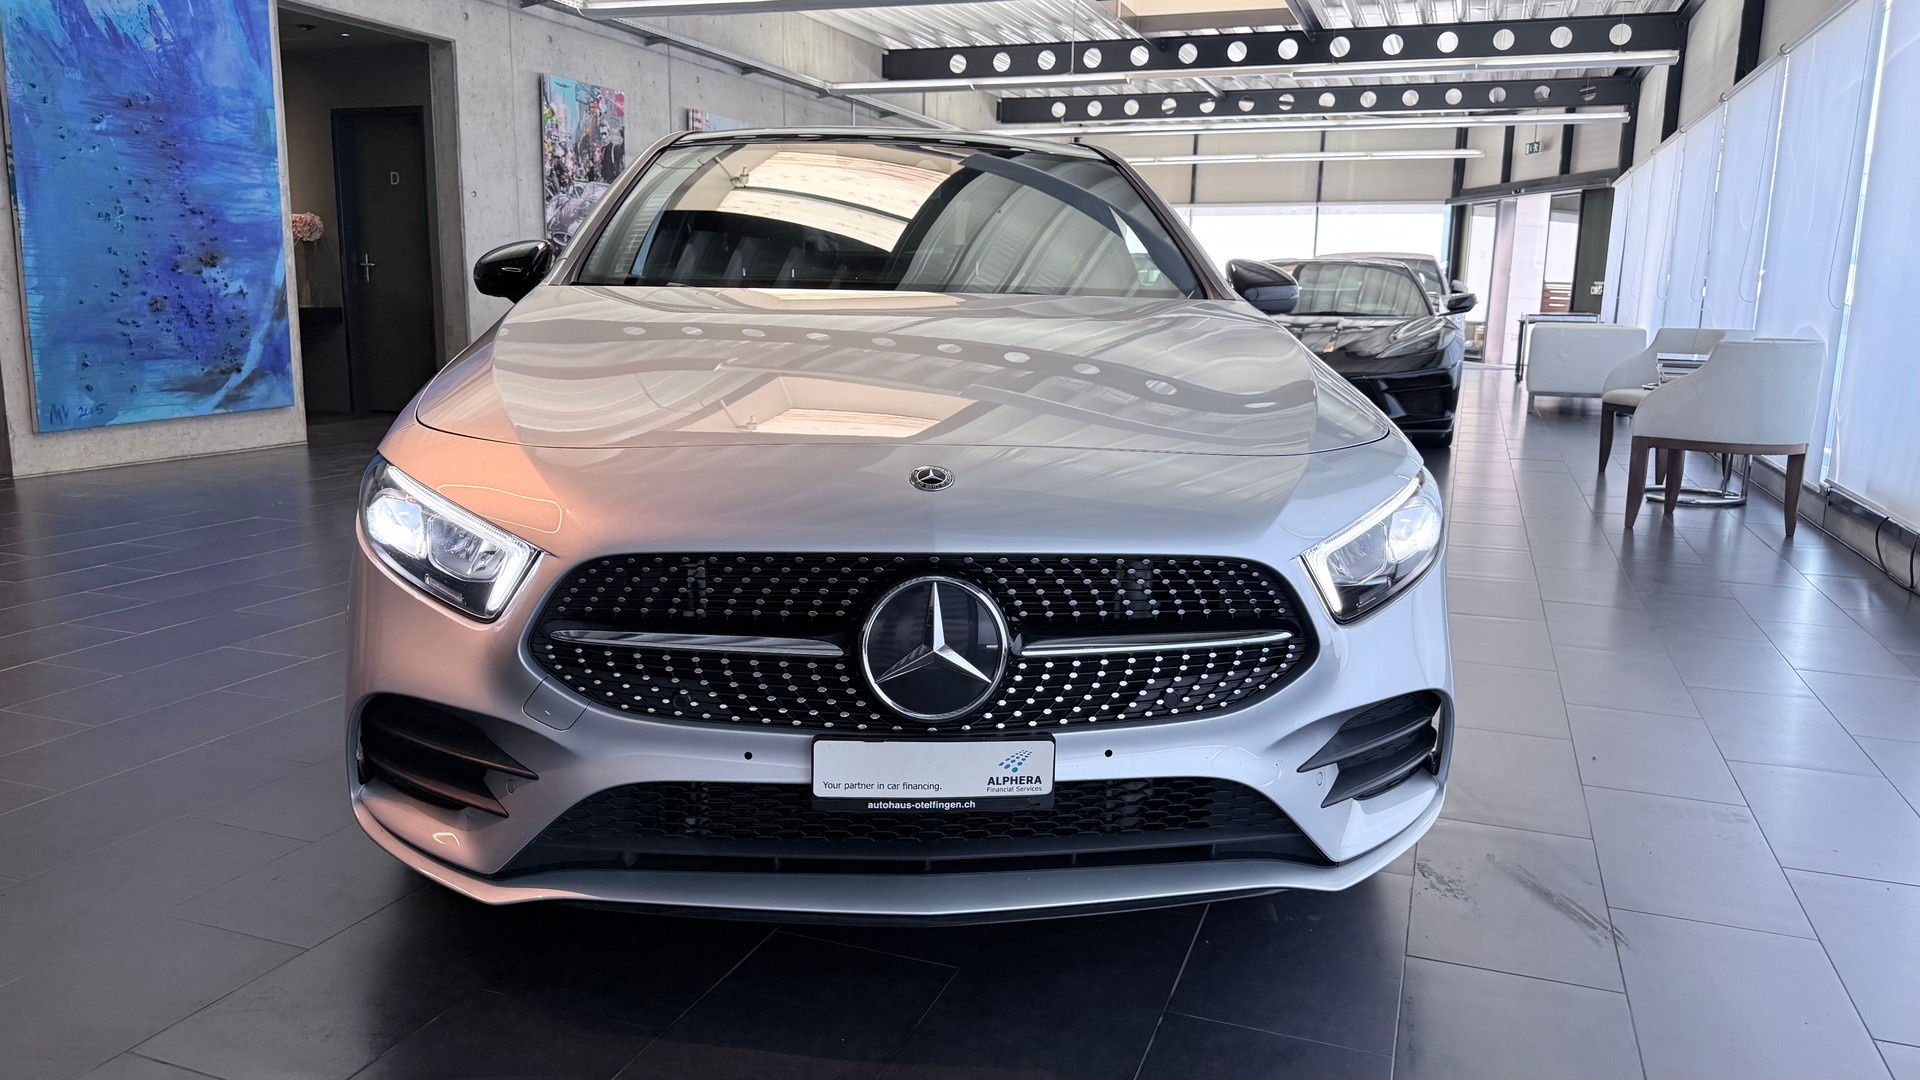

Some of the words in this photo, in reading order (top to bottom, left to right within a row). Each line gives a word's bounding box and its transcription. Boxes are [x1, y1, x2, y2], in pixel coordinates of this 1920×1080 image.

[390, 171, 400, 185] D
[987, 775, 1042, 786] ALPHERA
[823, 781, 841, 789] Your
[844, 782, 874, 791] partner
[877, 781, 885, 790] in
[902, 781, 942, 792] financing.
[867, 800, 976, 811] autohaus-otelfingen.ch
